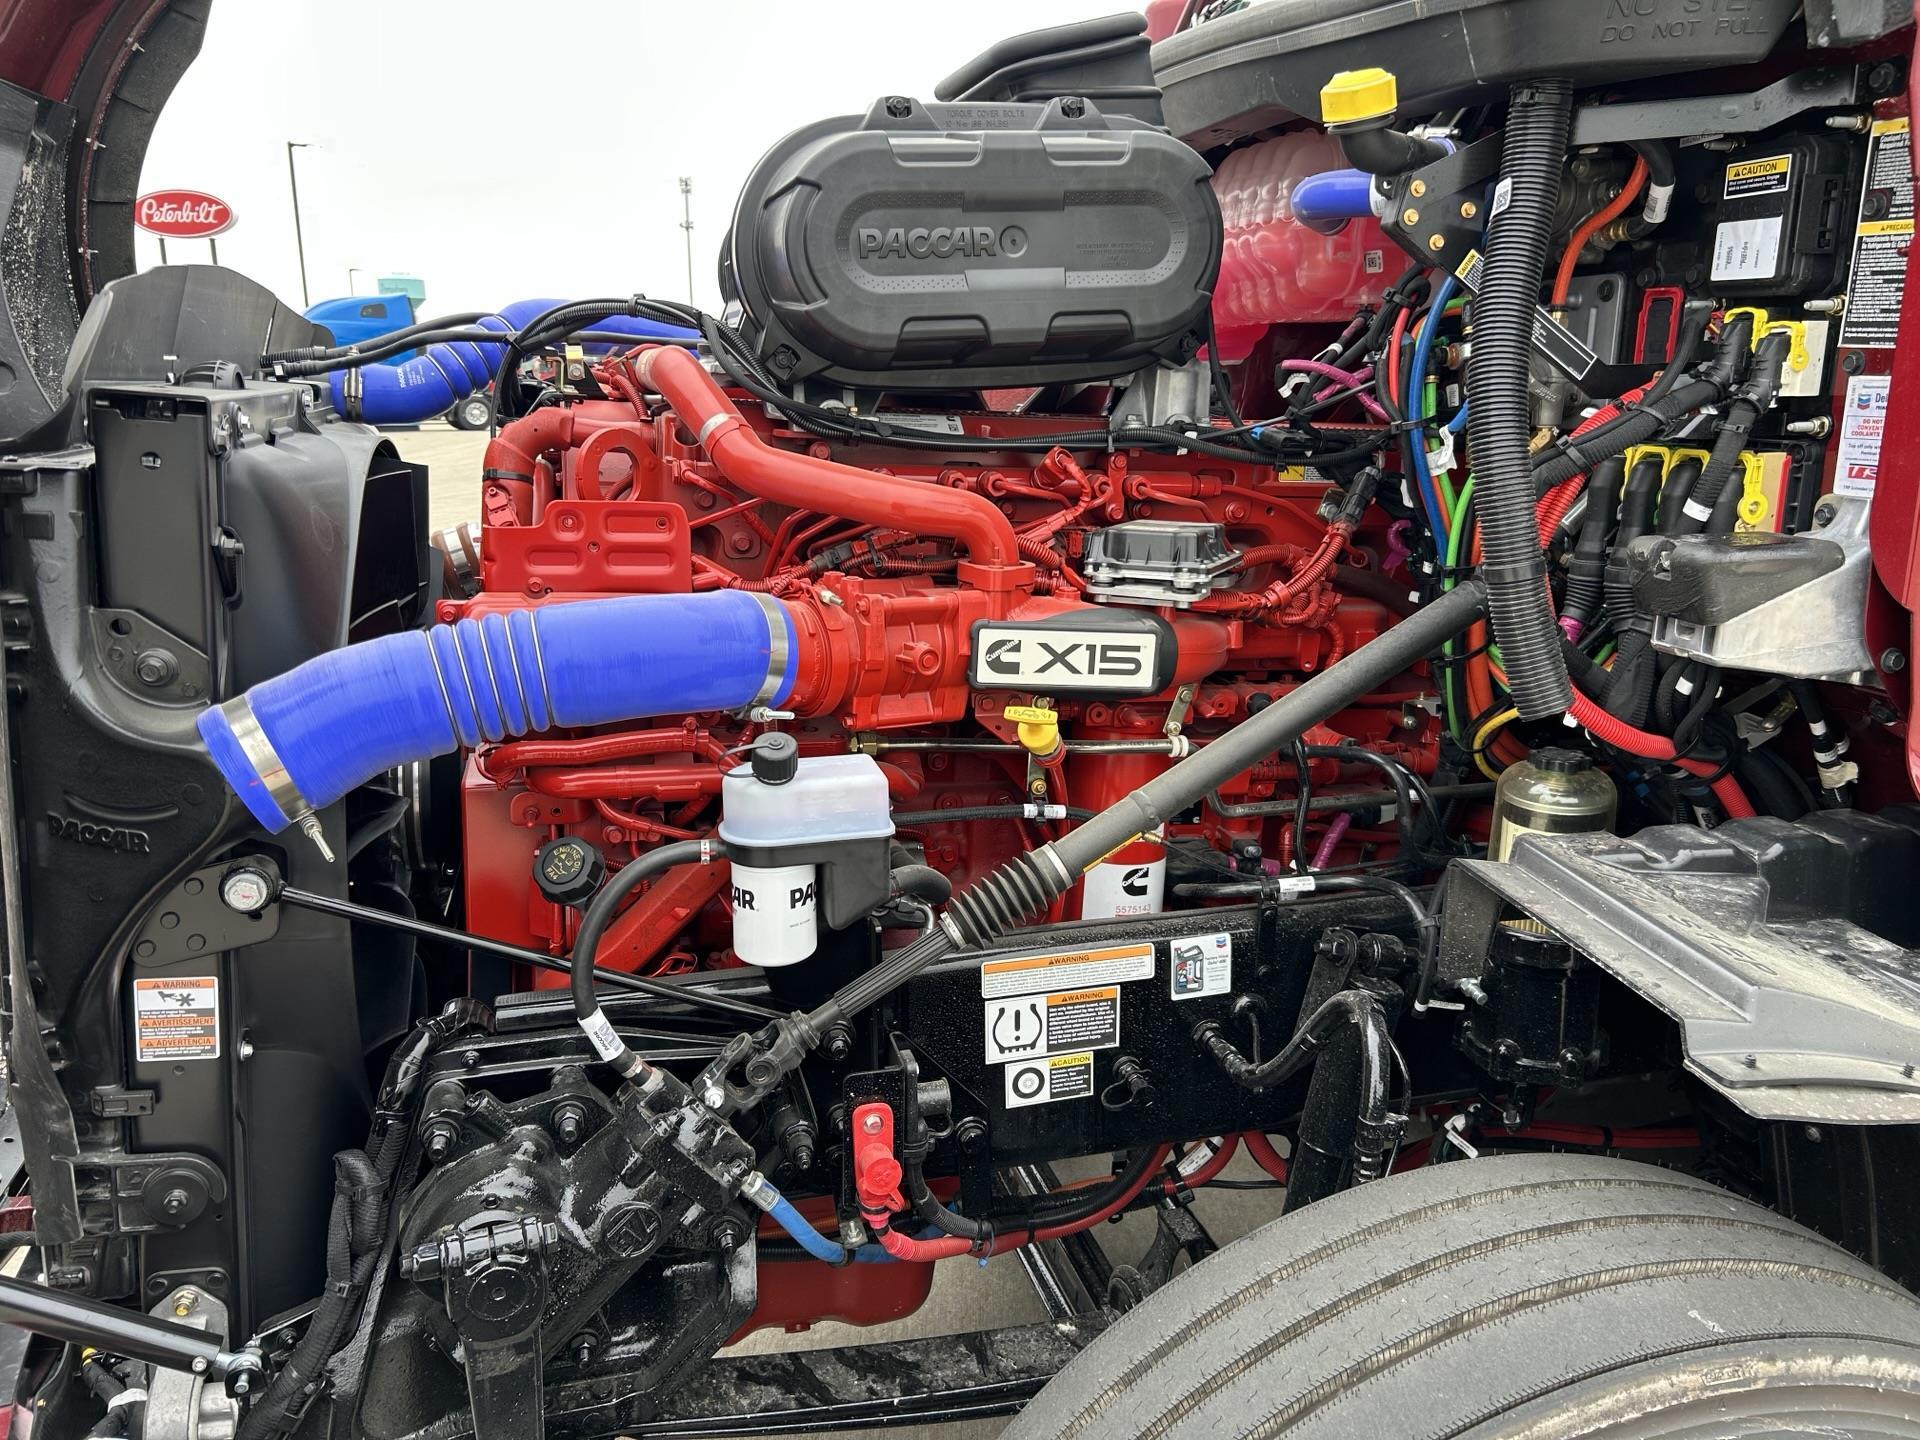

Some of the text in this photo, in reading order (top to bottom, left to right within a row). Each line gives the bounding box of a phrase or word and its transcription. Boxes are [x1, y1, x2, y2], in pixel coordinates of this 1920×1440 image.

[1600, 17, 1769, 43] DO NOT PULL
[1741, 162, 1777, 176] CAUTION
[141, 199, 224, 225] Peterbilt
[858, 226, 997, 259] PACCAR
[1459, 254, 1476, 275] CAUTION
[985, 639, 1020, 662] Cummins
[1033, 642, 1142, 676] X15
[47, 811, 150, 853] PACCAR
[553, 846, 581, 860] ENGINE
[571, 861, 581, 873] OIL
[731, 885, 755, 911] AR
[1055, 955, 1090, 965] WARNING
[162, 980, 201, 989] WARNING
[1068, 991, 1104, 1001] WARNING
[152, 1018, 214, 1027] AVERTISSEMENT
[157, 1039, 212, 1047] ADVERTENCIA
[1057, 1056, 1091, 1066] CAUTION
